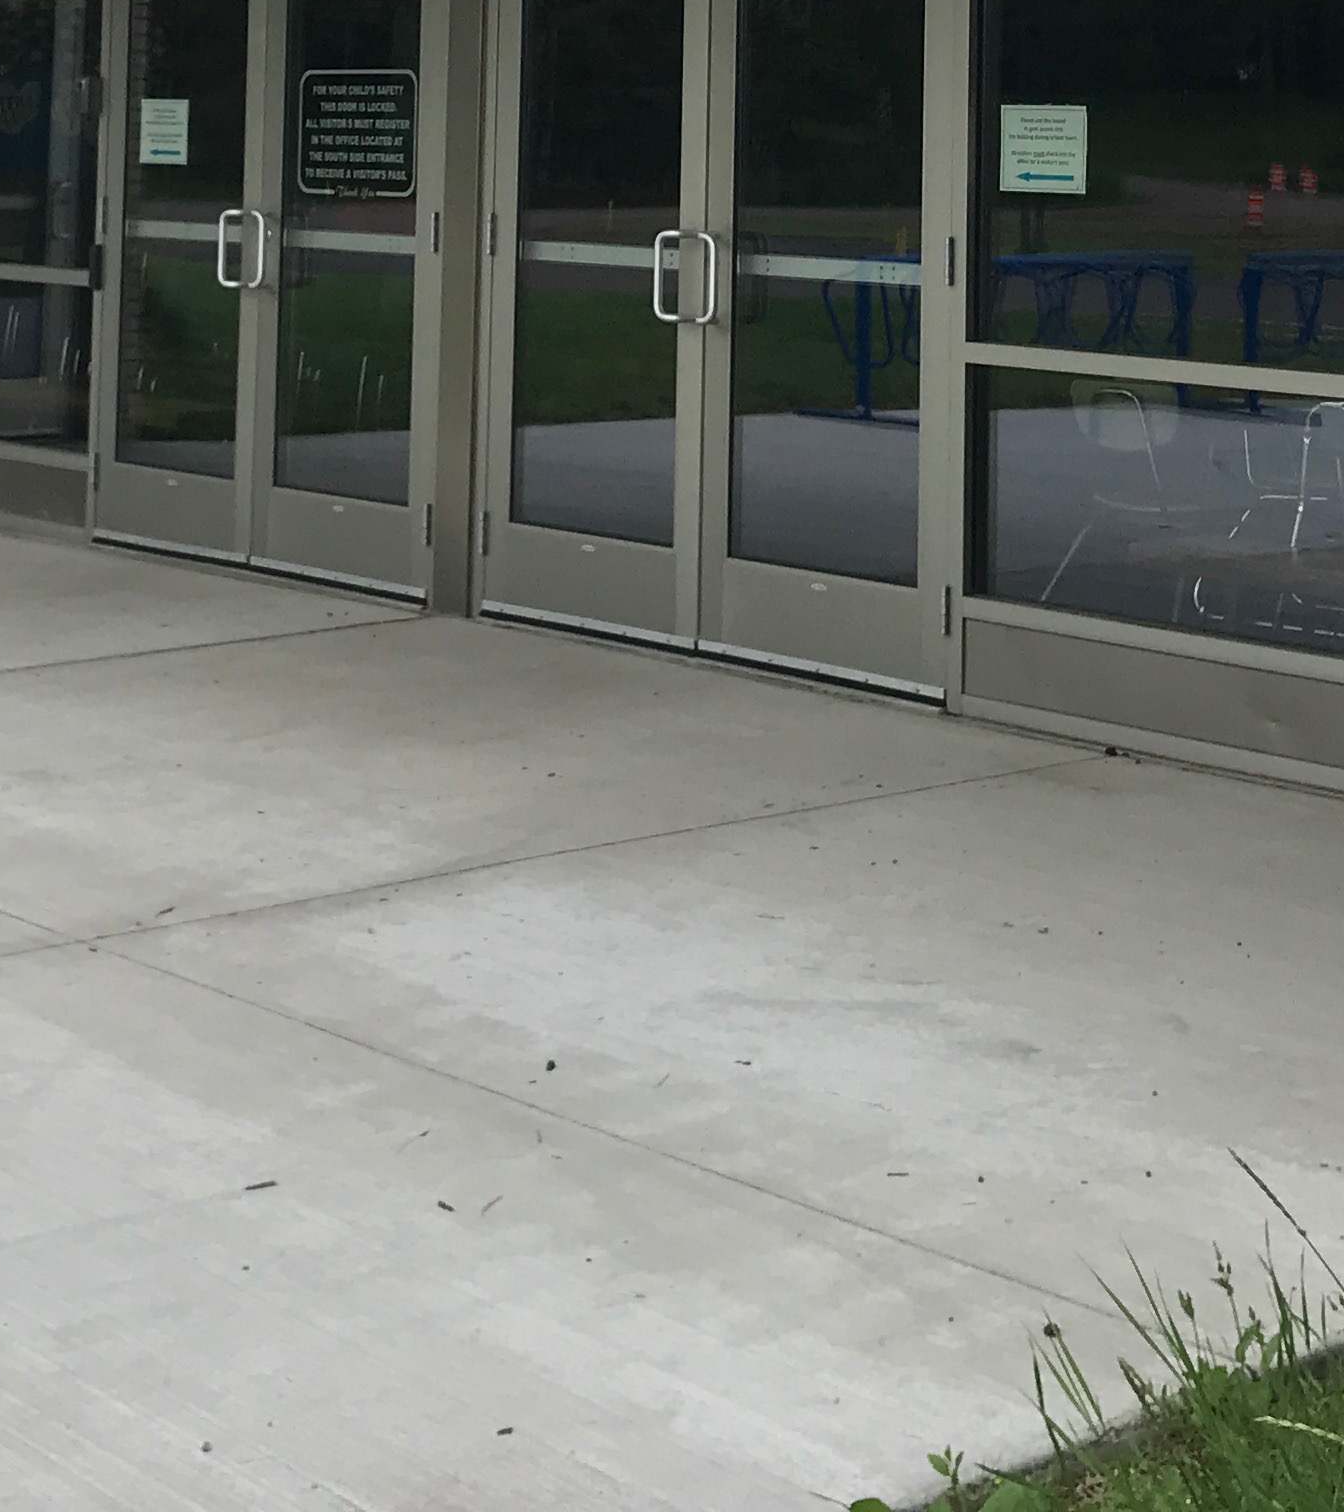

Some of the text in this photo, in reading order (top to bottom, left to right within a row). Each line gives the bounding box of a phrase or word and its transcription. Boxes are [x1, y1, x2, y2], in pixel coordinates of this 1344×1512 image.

[313, 85, 326, 96] FOR
[328, 85, 347, 96] YOUR
[377, 85, 404, 96] SAFETY
[320, 102, 336, 112] THIS
[337, 102, 357, 112] DOOR
[358, 102, 366, 112] IS
[305, 118, 318, 129] ALL
[354, 118, 374, 129] MUST
[375, 118, 410, 129] REGISTER
[311, 135, 404, 146] IN THE OFFICE LOCATED AT
[309, 151, 404, 163] THE SOUTH SIDE ENTRANCE
[305, 168, 314, 180] TO
[316, 168, 344, 180] RECEIVE
[345, 168, 351, 180] A
[337, 185, 358, 198] Thank
